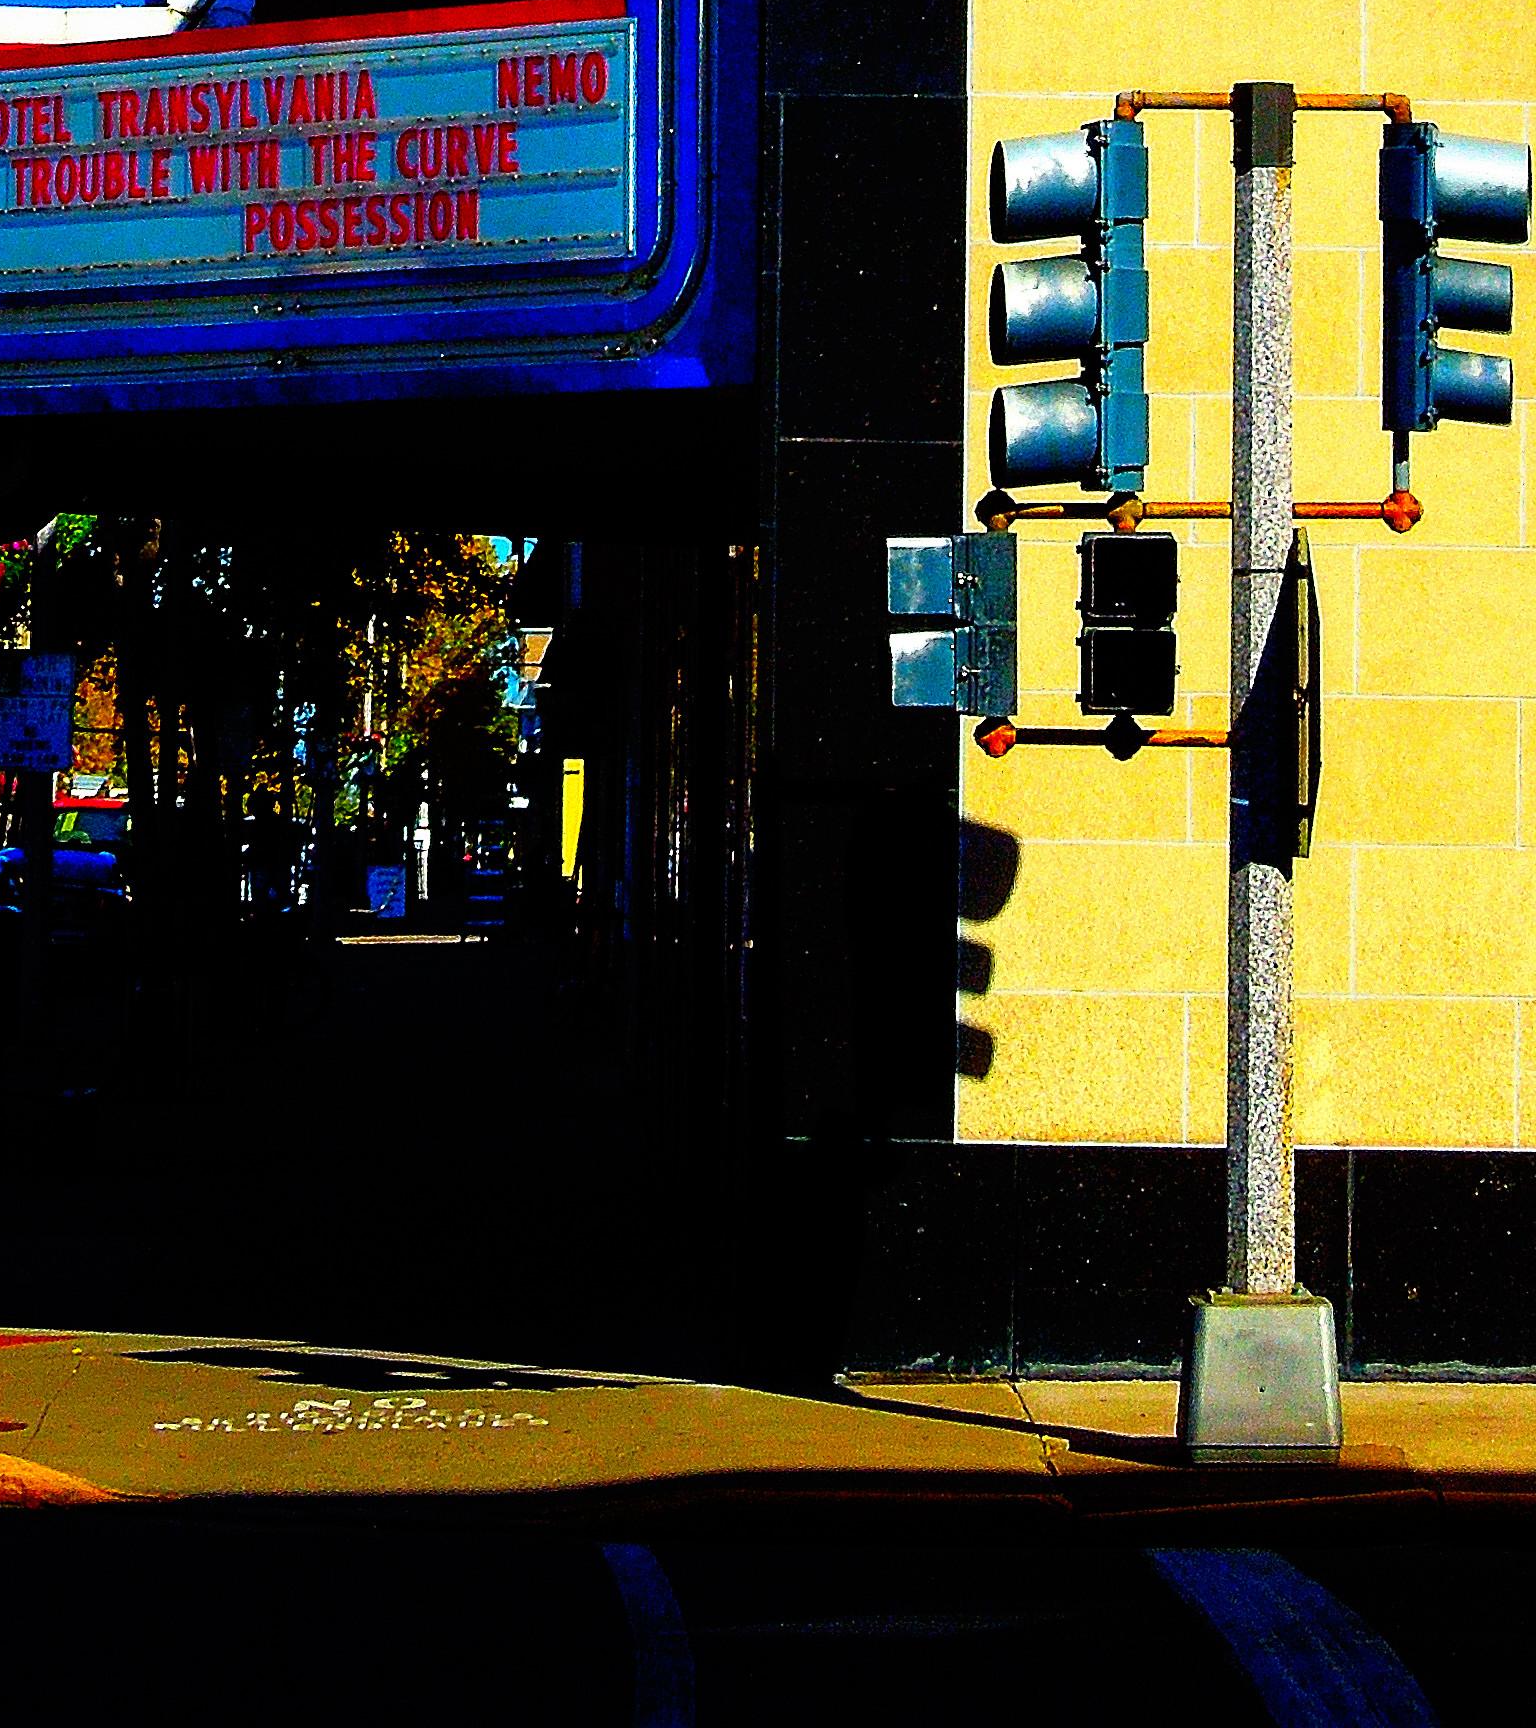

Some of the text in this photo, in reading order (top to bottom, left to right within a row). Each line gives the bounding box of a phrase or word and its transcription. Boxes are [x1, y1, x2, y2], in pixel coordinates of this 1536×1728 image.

[98, 69, 376, 138] TRANSYLVANIA
[497, 51, 608, 109] NEMO
[12, 122, 520, 206] TROUBLE WITH THE CURVE
[244, 188, 479, 253] POSSESSION
[294, 1398, 427, 1411] NO
